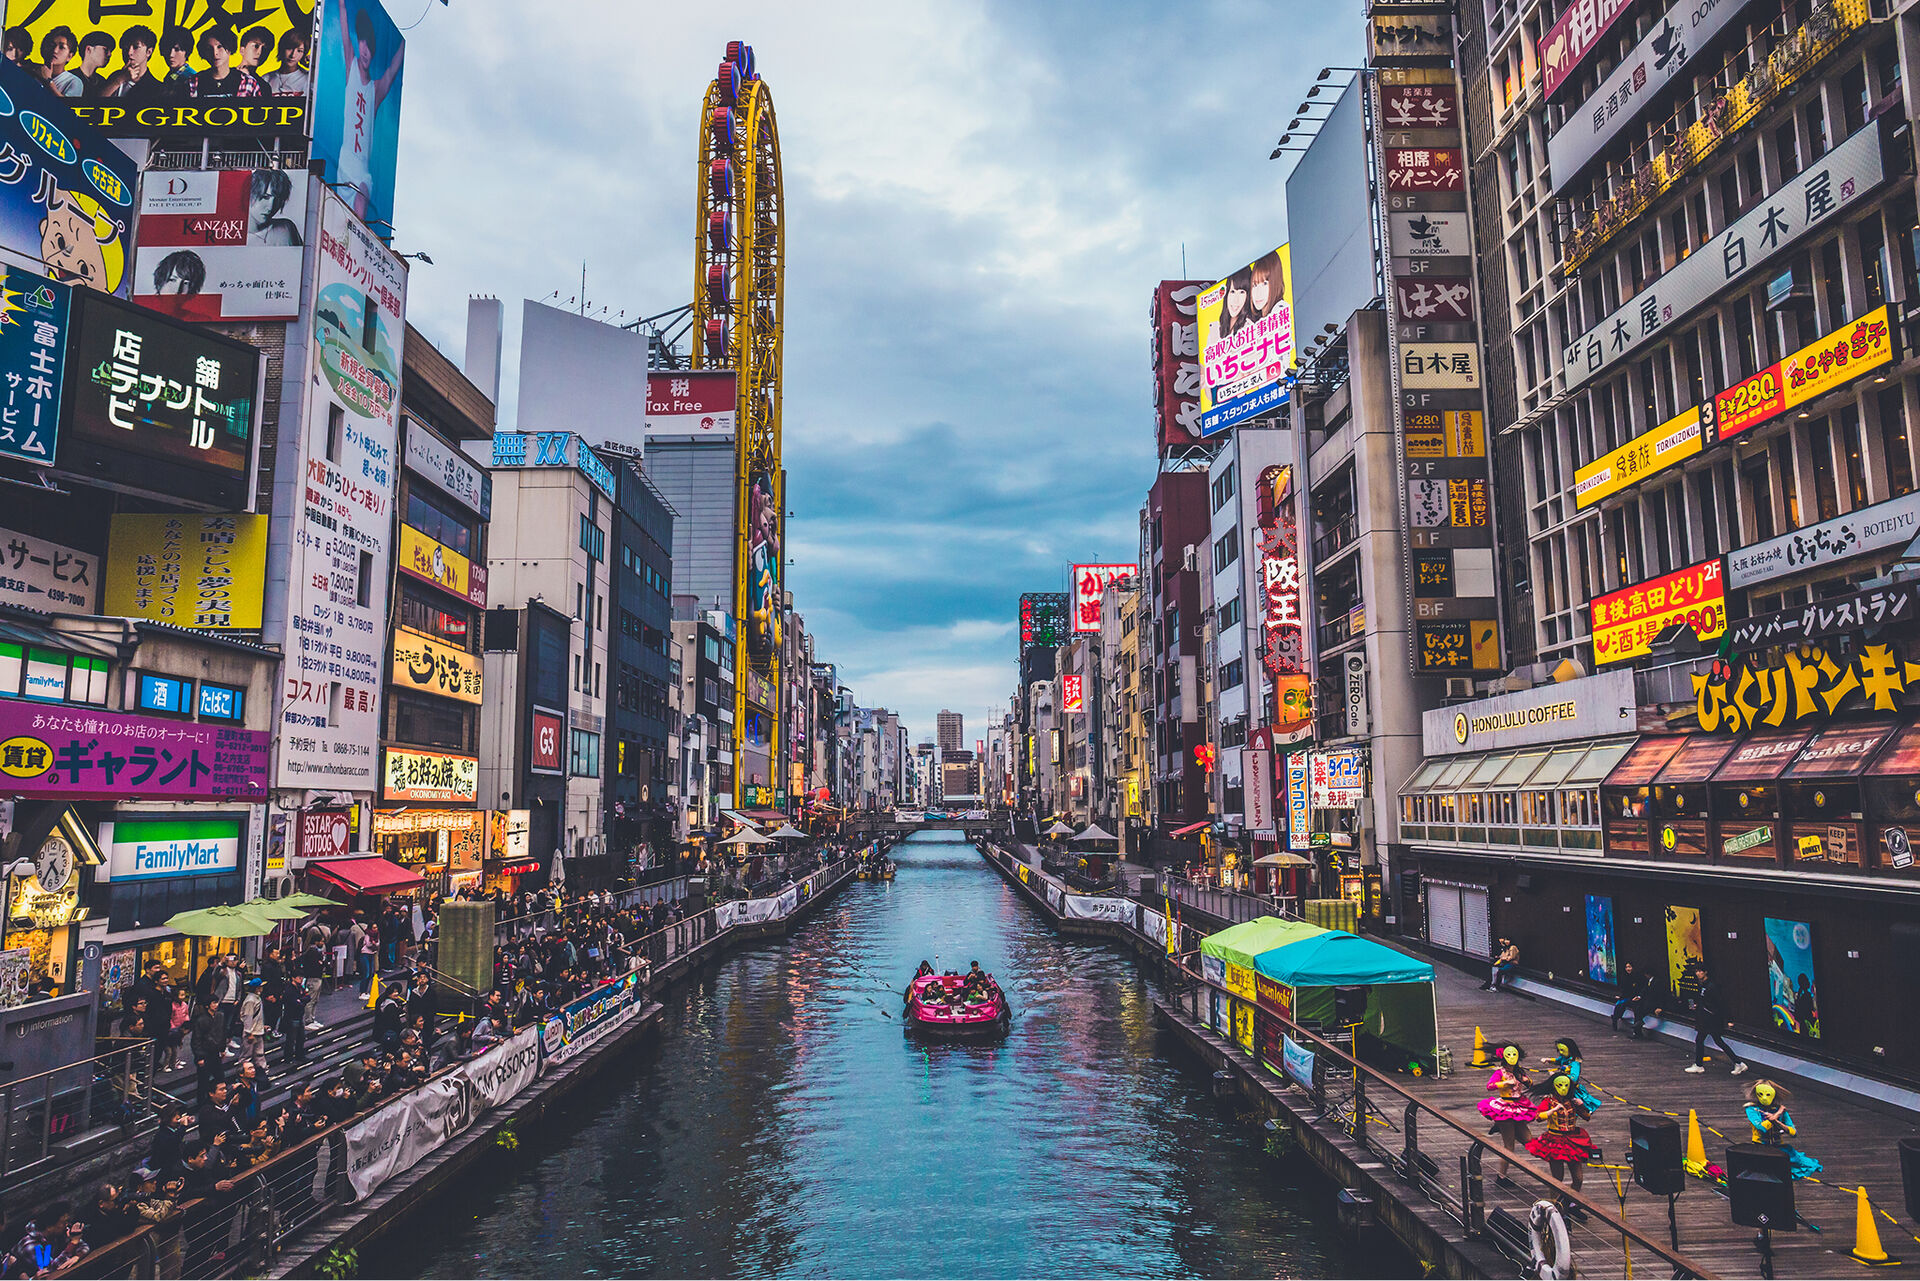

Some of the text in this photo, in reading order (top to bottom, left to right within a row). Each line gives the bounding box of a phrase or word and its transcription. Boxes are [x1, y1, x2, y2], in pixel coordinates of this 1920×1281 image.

[137, 107, 303, 127] GROUP
[354, 91, 367, 154] ホスト
[32, 117, 66, 160] リフォーム
[1398, 151, 1429, 167] 相席
[1388, 168, 1461, 188] ダイニング
[184, 218, 243, 235] KANZAKI
[205, 230, 242, 244] RUKA
[1723, 170, 1837, 280] 白木屋
[1410, 261, 1429, 273] 5F
[1206, 307, 1289, 363] 高収入お仕事情報
[1586, 295, 1661, 373] 白木屋
[1206, 326, 1291, 385] いちごナビ
[1405, 350, 1473, 374] 白木屋
[1567, 343, 1581, 366] 4F
[21, 320, 59, 456] 富士ホーム
[111, 362, 216, 416] テナント
[646, 401, 702, 411] Tax Free
[1702, 401, 1715, 444] 3F
[1863, 512, 1915, 538] BOTEJYU
[159, 518, 184, 617] あなたのお店づくり
[194, 517, 236, 628] 素晴らしい夢の実現
[1421, 562, 1446, 573] びっくり
[1703, 560, 1720, 582] 2F
[1733, 557, 1749, 573] 大阪
[1750, 547, 1783, 567] お好み焼
[135, 553, 158, 610] 応援します
[1257, 518, 1302, 673] 大阪王将
[1593, 572, 1704, 628] 豊後高田どり
[1733, 593, 1909, 645] ハンバーグレストラン
[1425, 633, 1465, 650] びっくり
[409, 644, 463, 693] うなぎ
[1423, 650, 1469, 667] ドンキー
[25, 673, 64, 689] FamilyMart
[152, 681, 169, 708] 酒
[287, 679, 328, 705] コスパ
[1349, 674, 1361, 704] ZERO
[201, 689, 230, 717] たばこ
[1471, 700, 1577, 733] HONOLULU COFFEE
[540, 726, 555, 756] G3
[2, 738, 211, 788] 賃貸 の ギャラント
[407, 756, 454, 788] お好み焼
[410, 789, 451, 799] OKONOMIYAKI
[1291, 769, 1306, 811] ダイコク
[1327, 790, 1348, 806] 免税
[305, 815, 331, 834] 5STAR
[1829, 829, 1845, 839] KEEP
[135, 843, 220, 871] FamilyMart
[304, 834, 332, 853] HOTDOG
[29, 1013, 73, 1032] information
[494, 1043, 538, 1086] RESORTS
